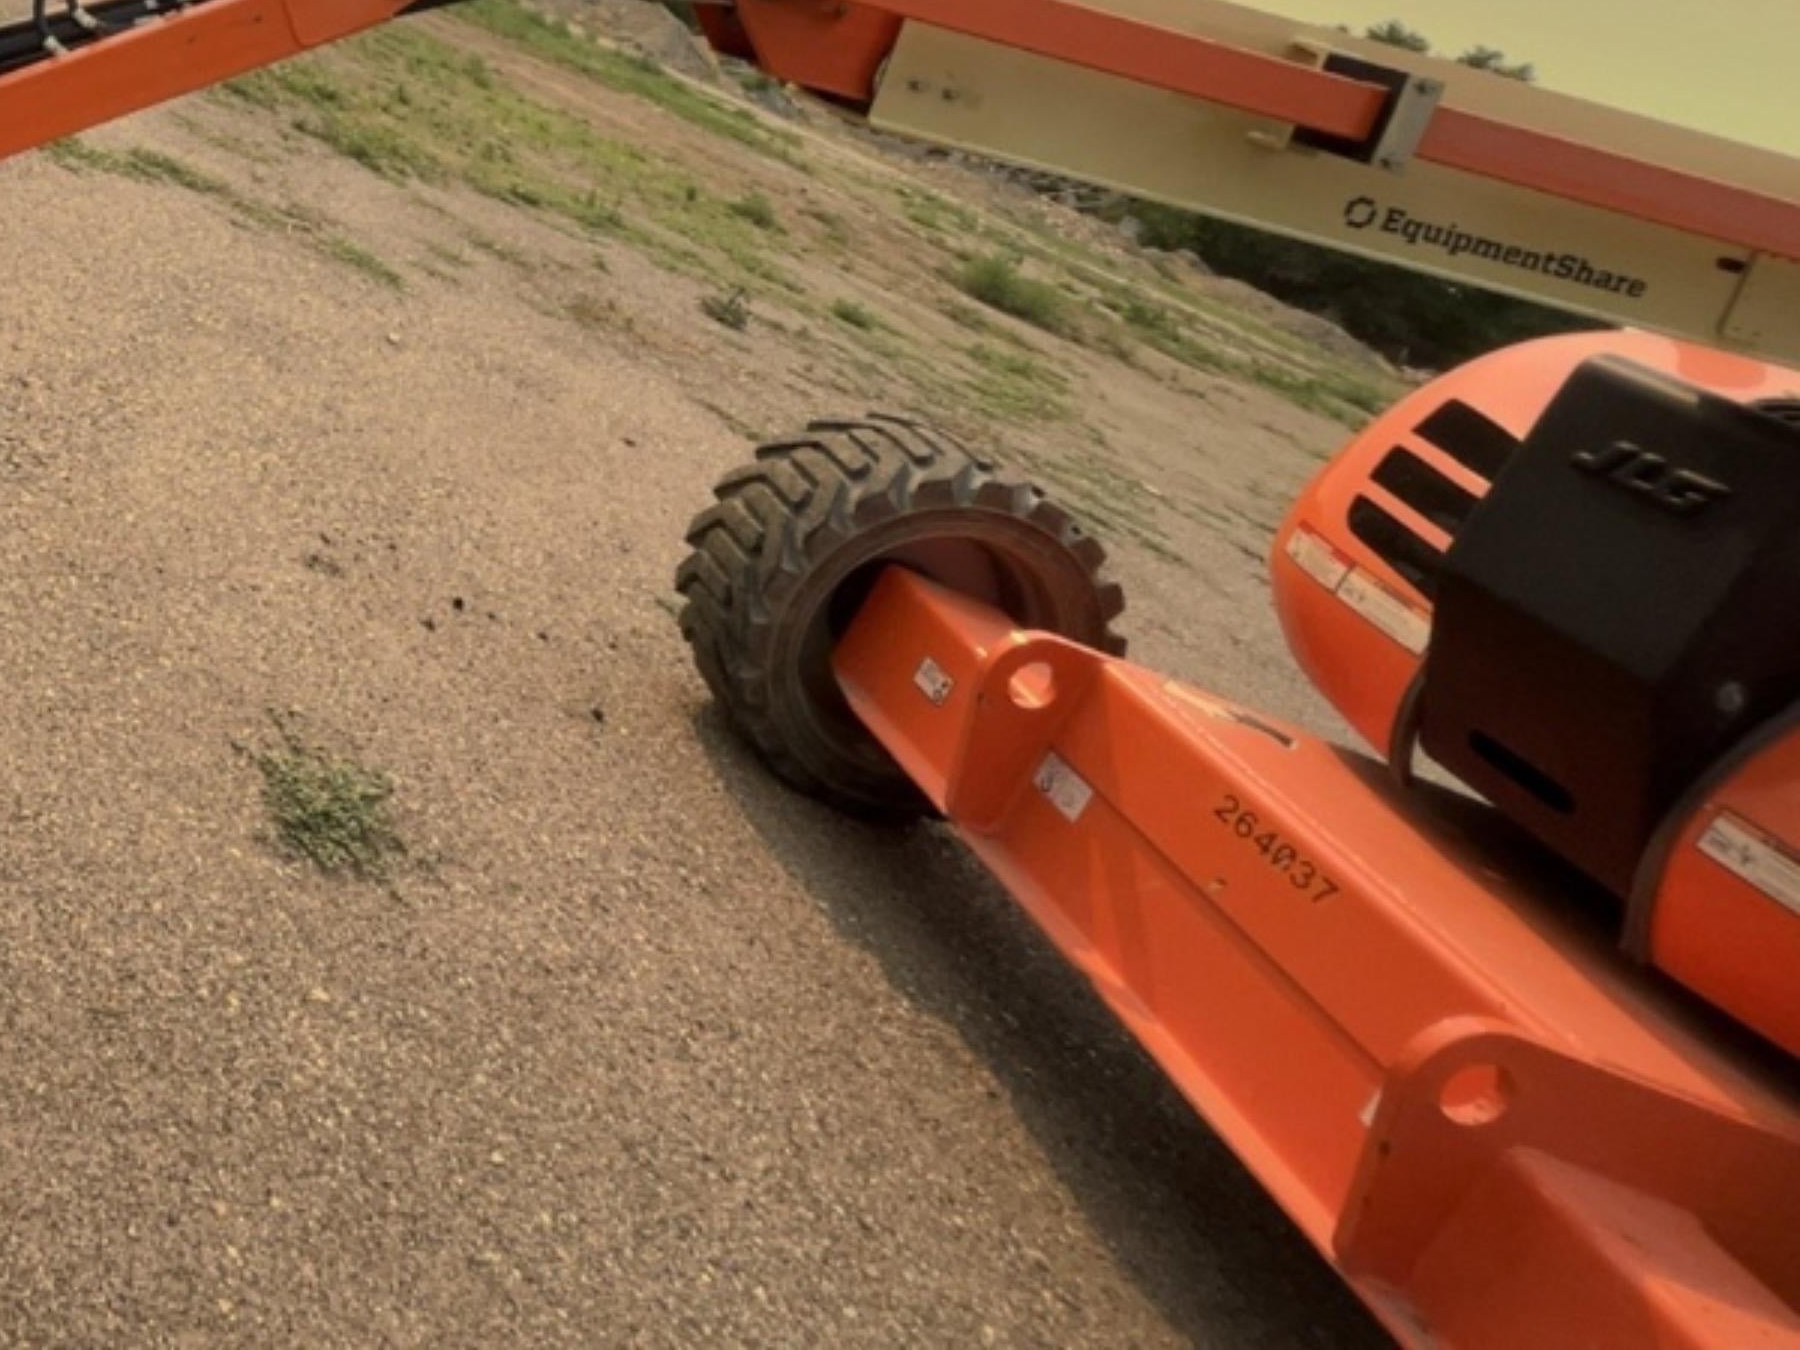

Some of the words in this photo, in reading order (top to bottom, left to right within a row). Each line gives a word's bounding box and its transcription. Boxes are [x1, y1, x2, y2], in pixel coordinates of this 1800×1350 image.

[1379, 205, 1648, 298] EquipmentShare
[1571, 438, 1734, 508] JLG
[1214, 794, 1340, 904] 264037
